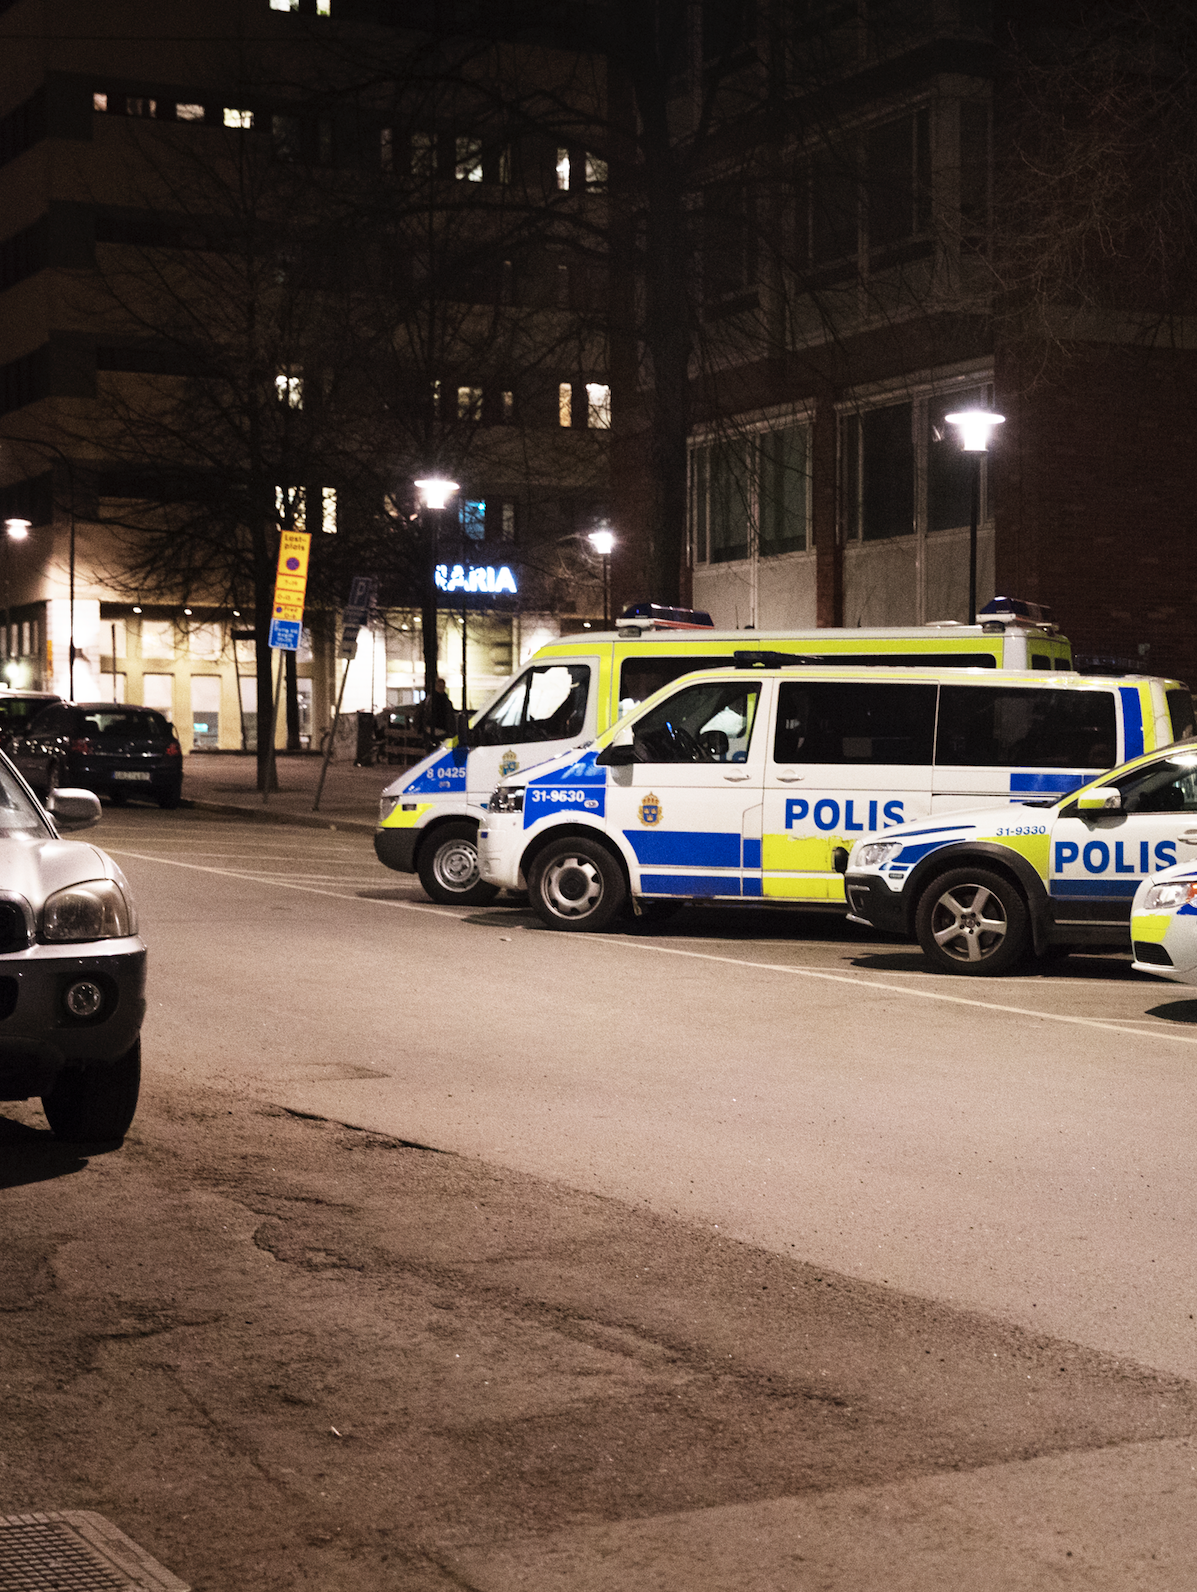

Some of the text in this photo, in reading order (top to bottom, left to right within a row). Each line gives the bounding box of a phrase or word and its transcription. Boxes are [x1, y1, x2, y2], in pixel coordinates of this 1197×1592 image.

[437, 766, 466, 779] 0425
[784, 798, 905, 831] POLIS
[995, 825, 1046, 837] 31-9330
[1054, 840, 1177, 874] POLIS
